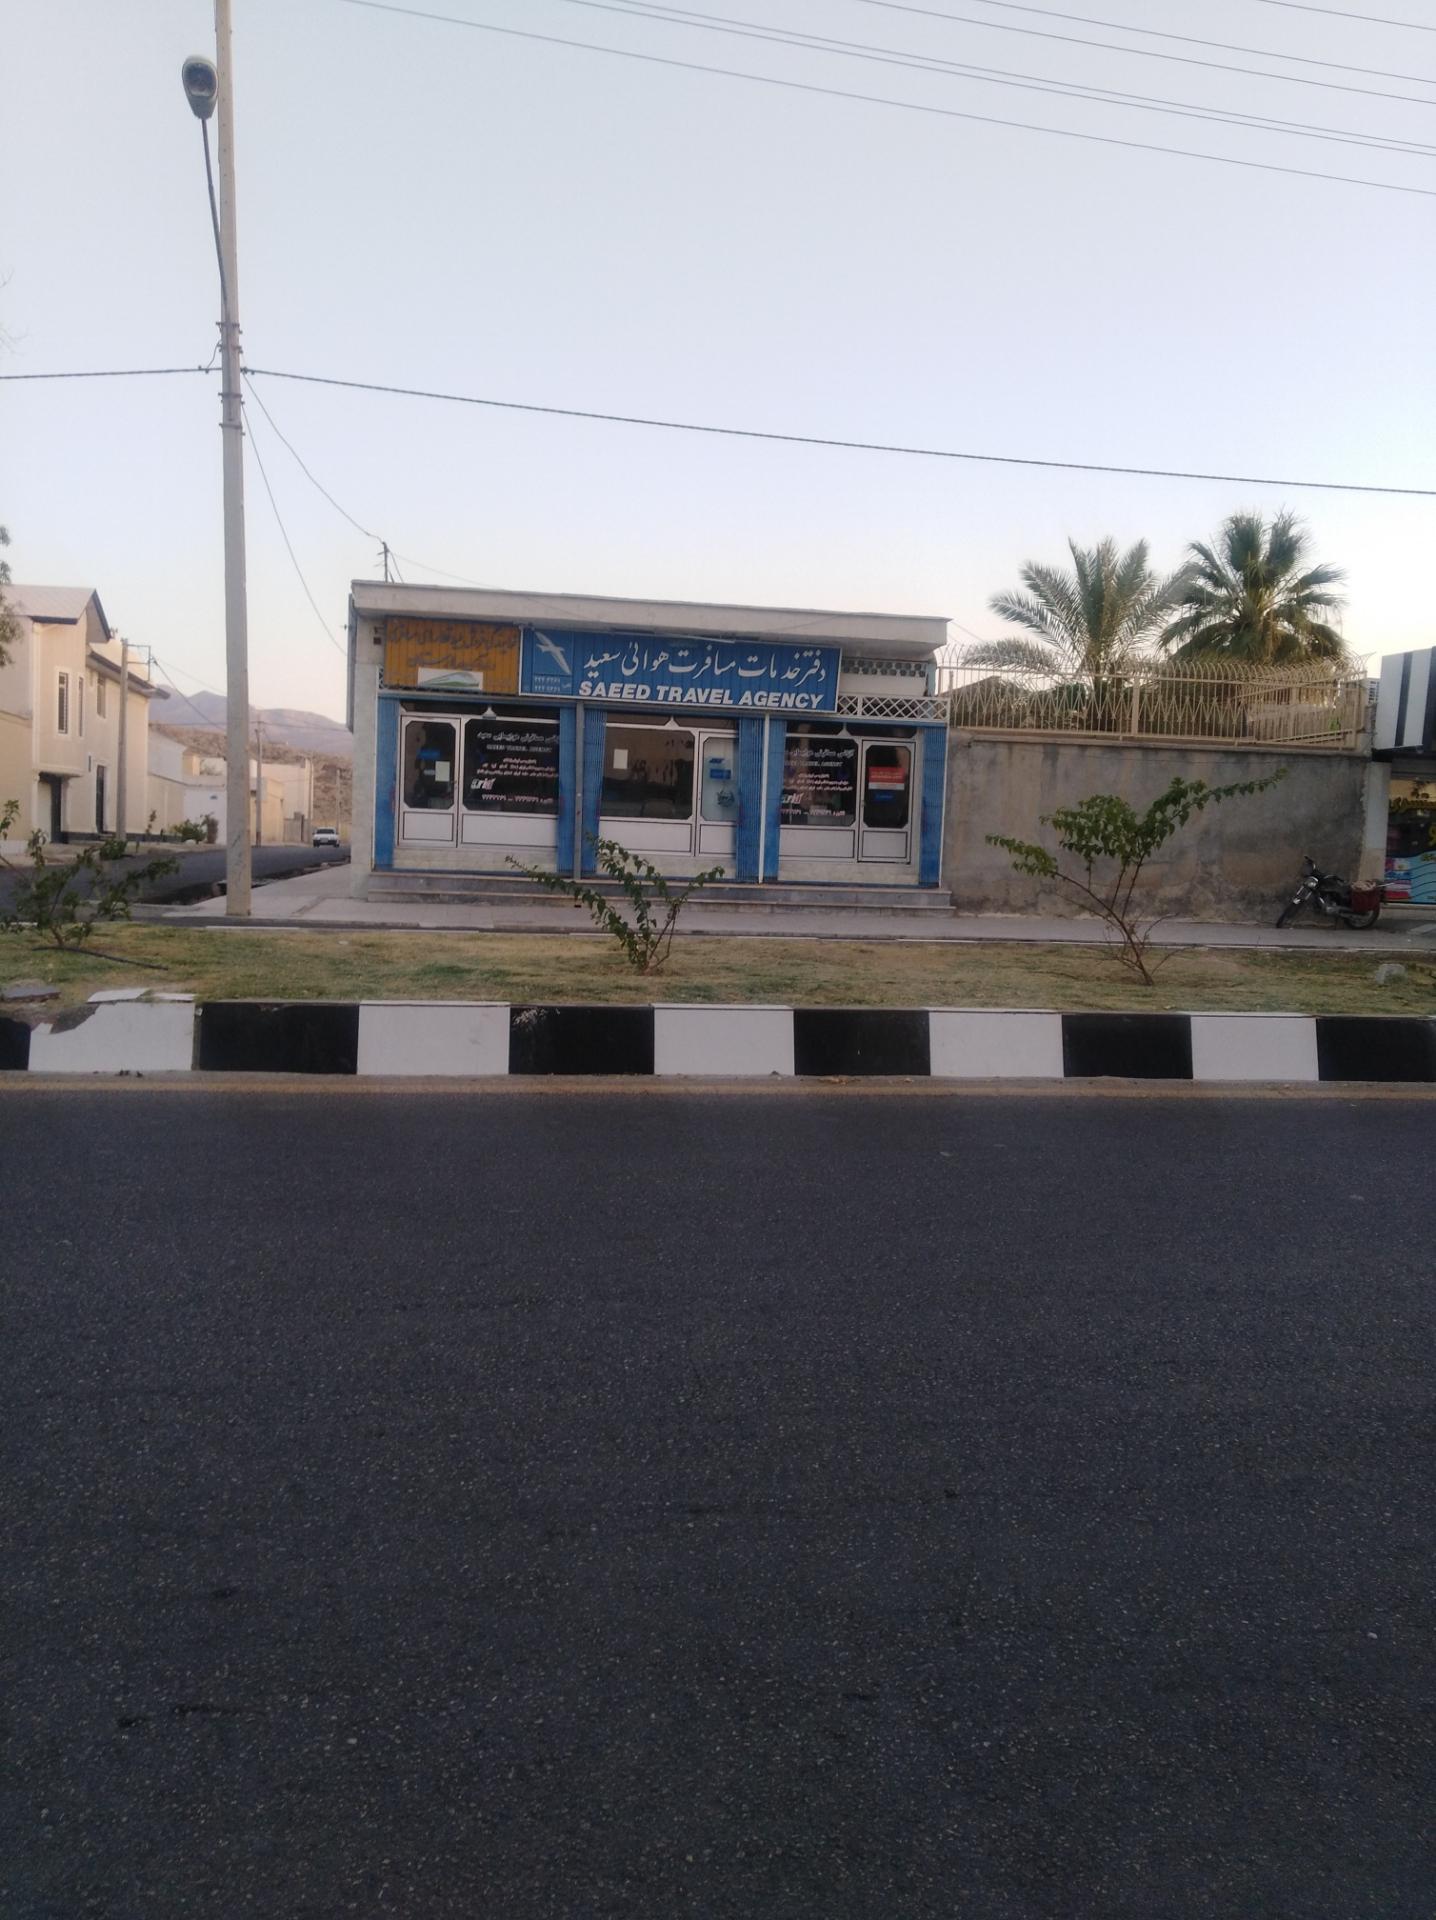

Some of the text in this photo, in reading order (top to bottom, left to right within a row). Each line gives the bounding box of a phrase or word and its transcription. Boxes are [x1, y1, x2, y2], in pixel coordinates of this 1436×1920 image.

[583, 651, 621, 678] سعید
[668, 643, 736, 679] مسافرت
[738, 652, 801, 680] خدمات
[794, 649, 826, 687] دفتر
[578, 680, 651, 699] SAEED
[656, 685, 734, 704] TRAVEL
[738, 690, 824, 709] AGENCY
